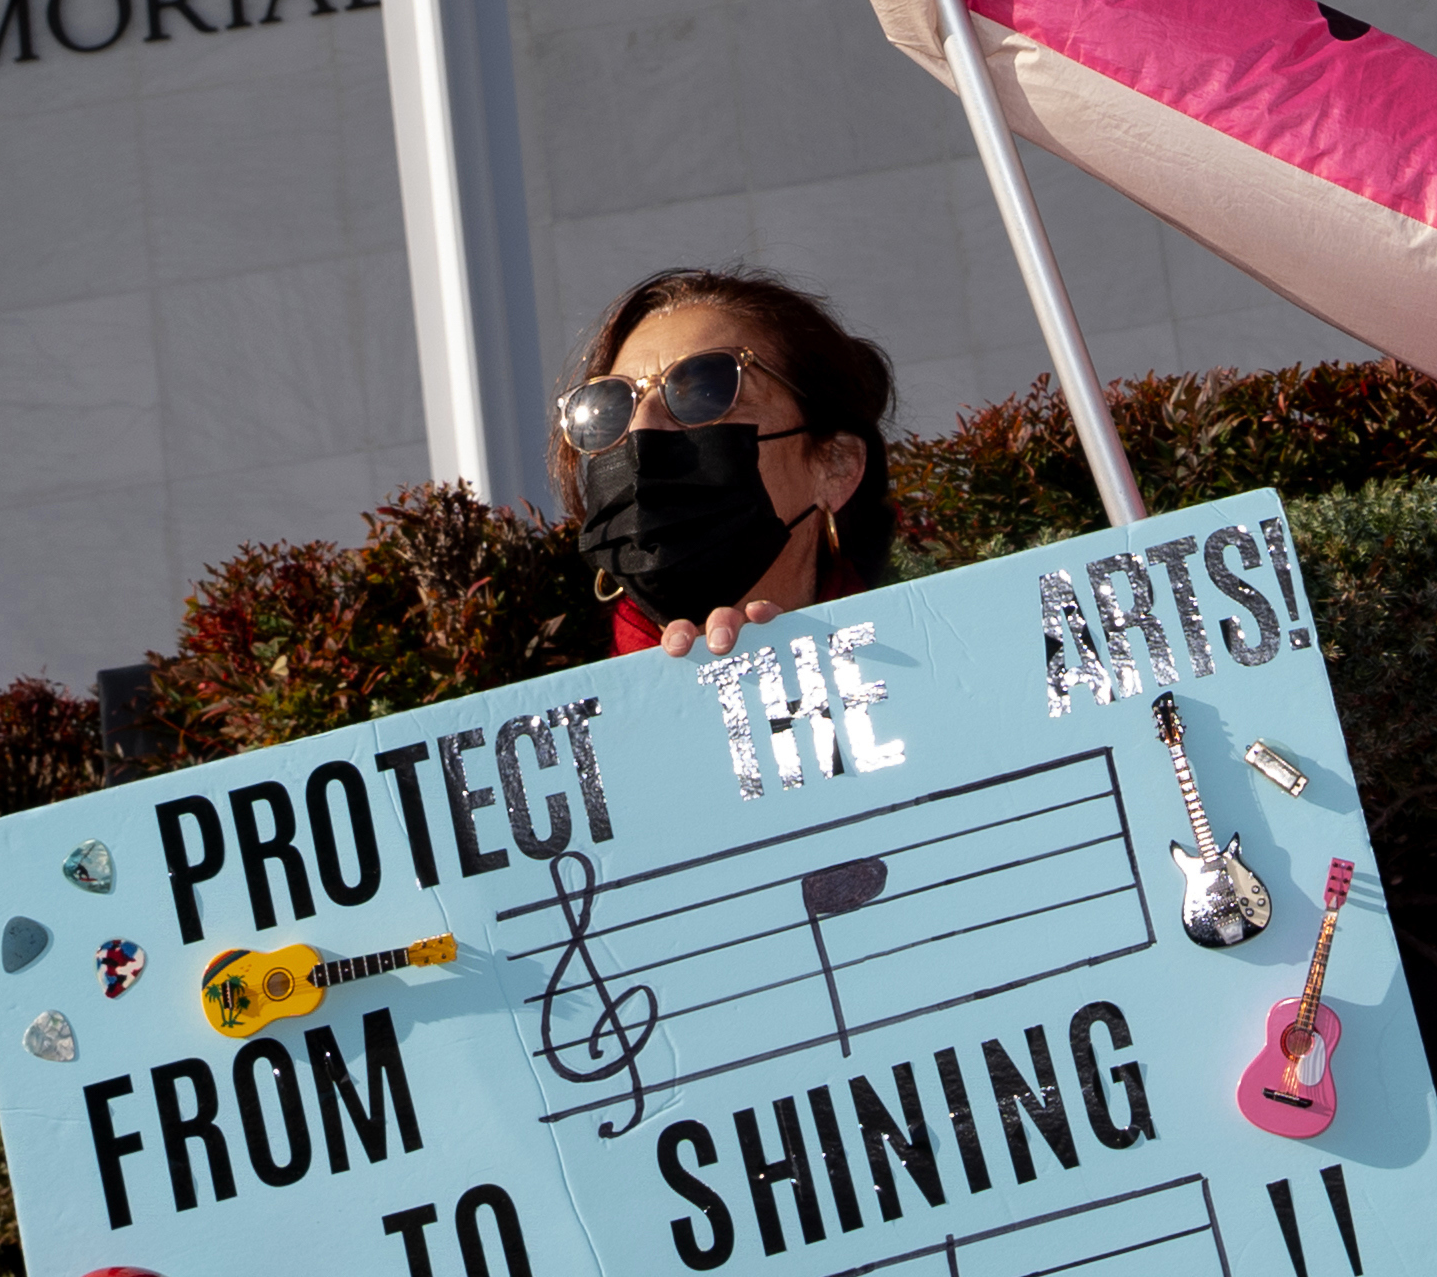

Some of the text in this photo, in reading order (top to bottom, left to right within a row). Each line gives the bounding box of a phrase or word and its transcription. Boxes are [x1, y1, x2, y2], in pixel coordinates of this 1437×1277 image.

[153, 515, 1313, 946] PROTECT THE ARTS!
[81, 1006, 425, 1231] FROM
[380, 999, 1158, 1277] TO SHINING
